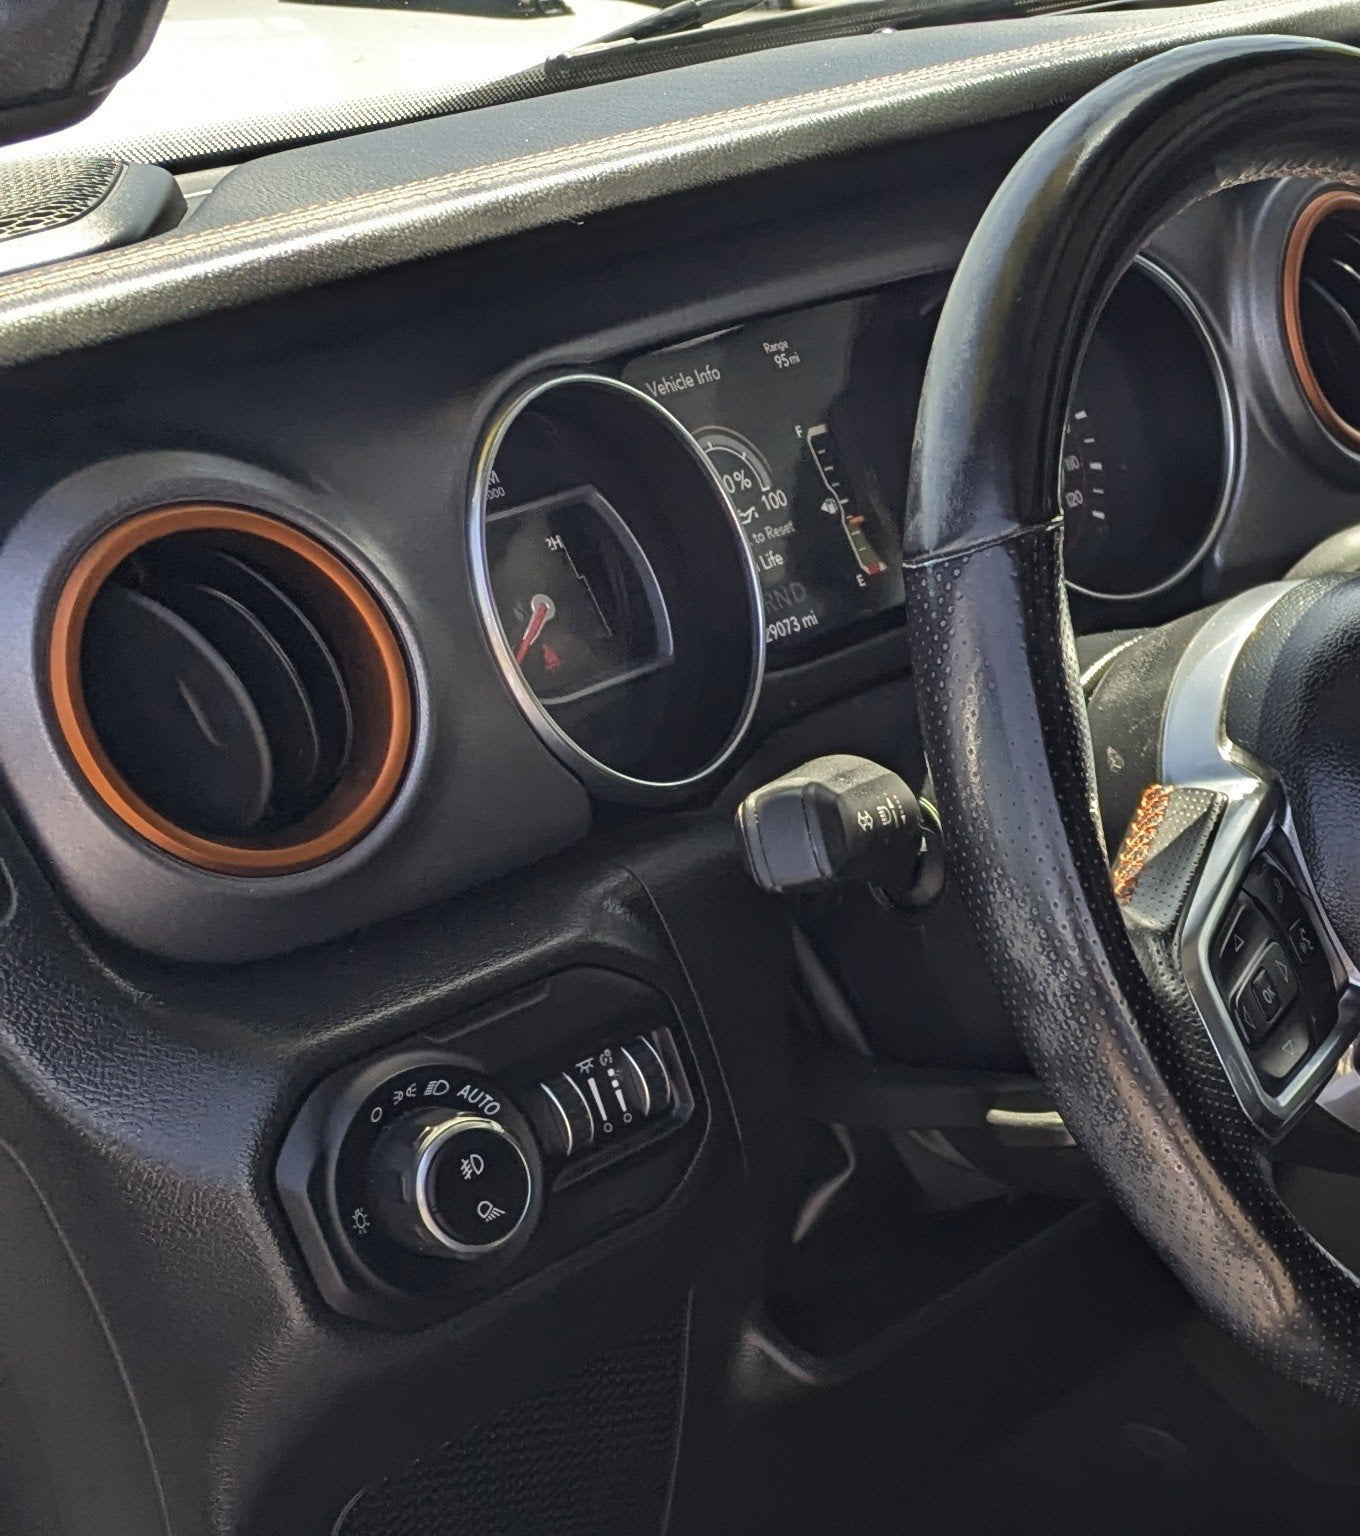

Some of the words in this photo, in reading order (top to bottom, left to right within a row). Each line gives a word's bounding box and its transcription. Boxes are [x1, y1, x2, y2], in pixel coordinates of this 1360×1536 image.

[763, 340, 789, 354] Range
[645, 371, 695, 398] Vehicle
[696, 364, 722, 386] Info
[794, 424, 804, 439] F
[761, 489, 788, 511] 100
[752, 531, 766, 545] to
[765, 520, 796, 540] Reset
[758, 550, 785, 572] Life
[855, 573, 867, 588] E
[801, 610, 819, 629] mi
[457, 1084, 501, 1116] AUTO
